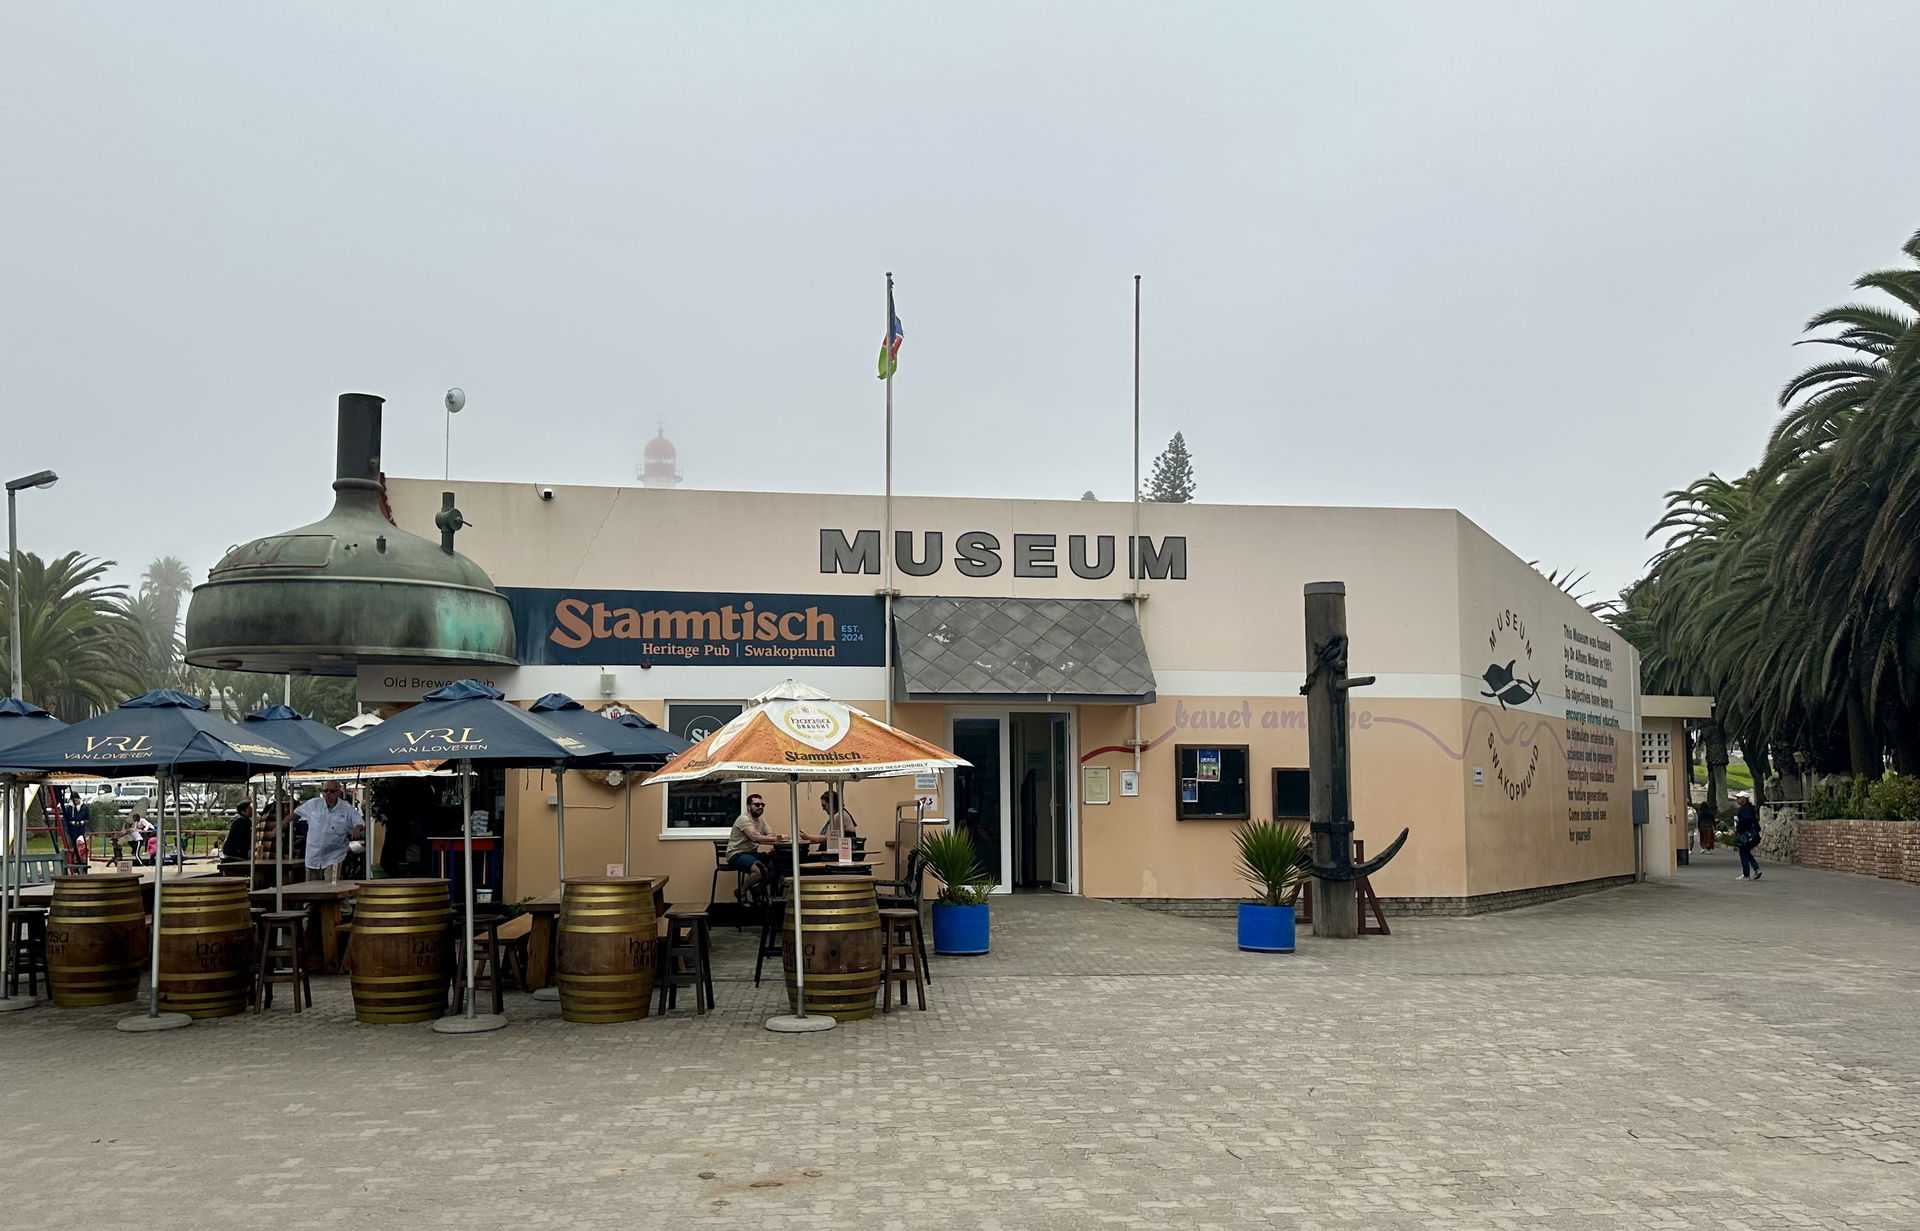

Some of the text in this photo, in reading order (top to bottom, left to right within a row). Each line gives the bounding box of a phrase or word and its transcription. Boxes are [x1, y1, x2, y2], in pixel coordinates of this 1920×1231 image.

[819, 528, 1188, 580] MUSEUM
[549, 598, 836, 649] Stammtisch
[841, 625, 860, 633] EST.
[841, 633, 864, 641] 2024
[1489, 609, 1532, 660] MUSEUM
[1563, 624, 1611, 653] This Museum was founded
[642, 642, 836, 660] Heritage Pub Swakopmund
[383, 677, 407, 688] Old
[411, 677, 454, 688] Brewe
[1565, 664, 1574, 680] Ever
[1574, 668, 1585, 682] since
[1591, 672, 1608, 690] inception
[1571, 687, 1590, 704] objectives
[1261, 710, 1307, 729] am
[1566, 709, 1586, 726] encourage
[63, 751, 153, 760] VAN LOVEREN
[421, 744, 488, 752] LOVEREN
[784, 750, 862, 762] Stammtisch
[1488, 732, 1539, 801] SWAKOPMUND
[1569, 807, 1580, 821] Come
[1580, 807, 1592, 821] inside
[1592, 807, 1600, 821] and
